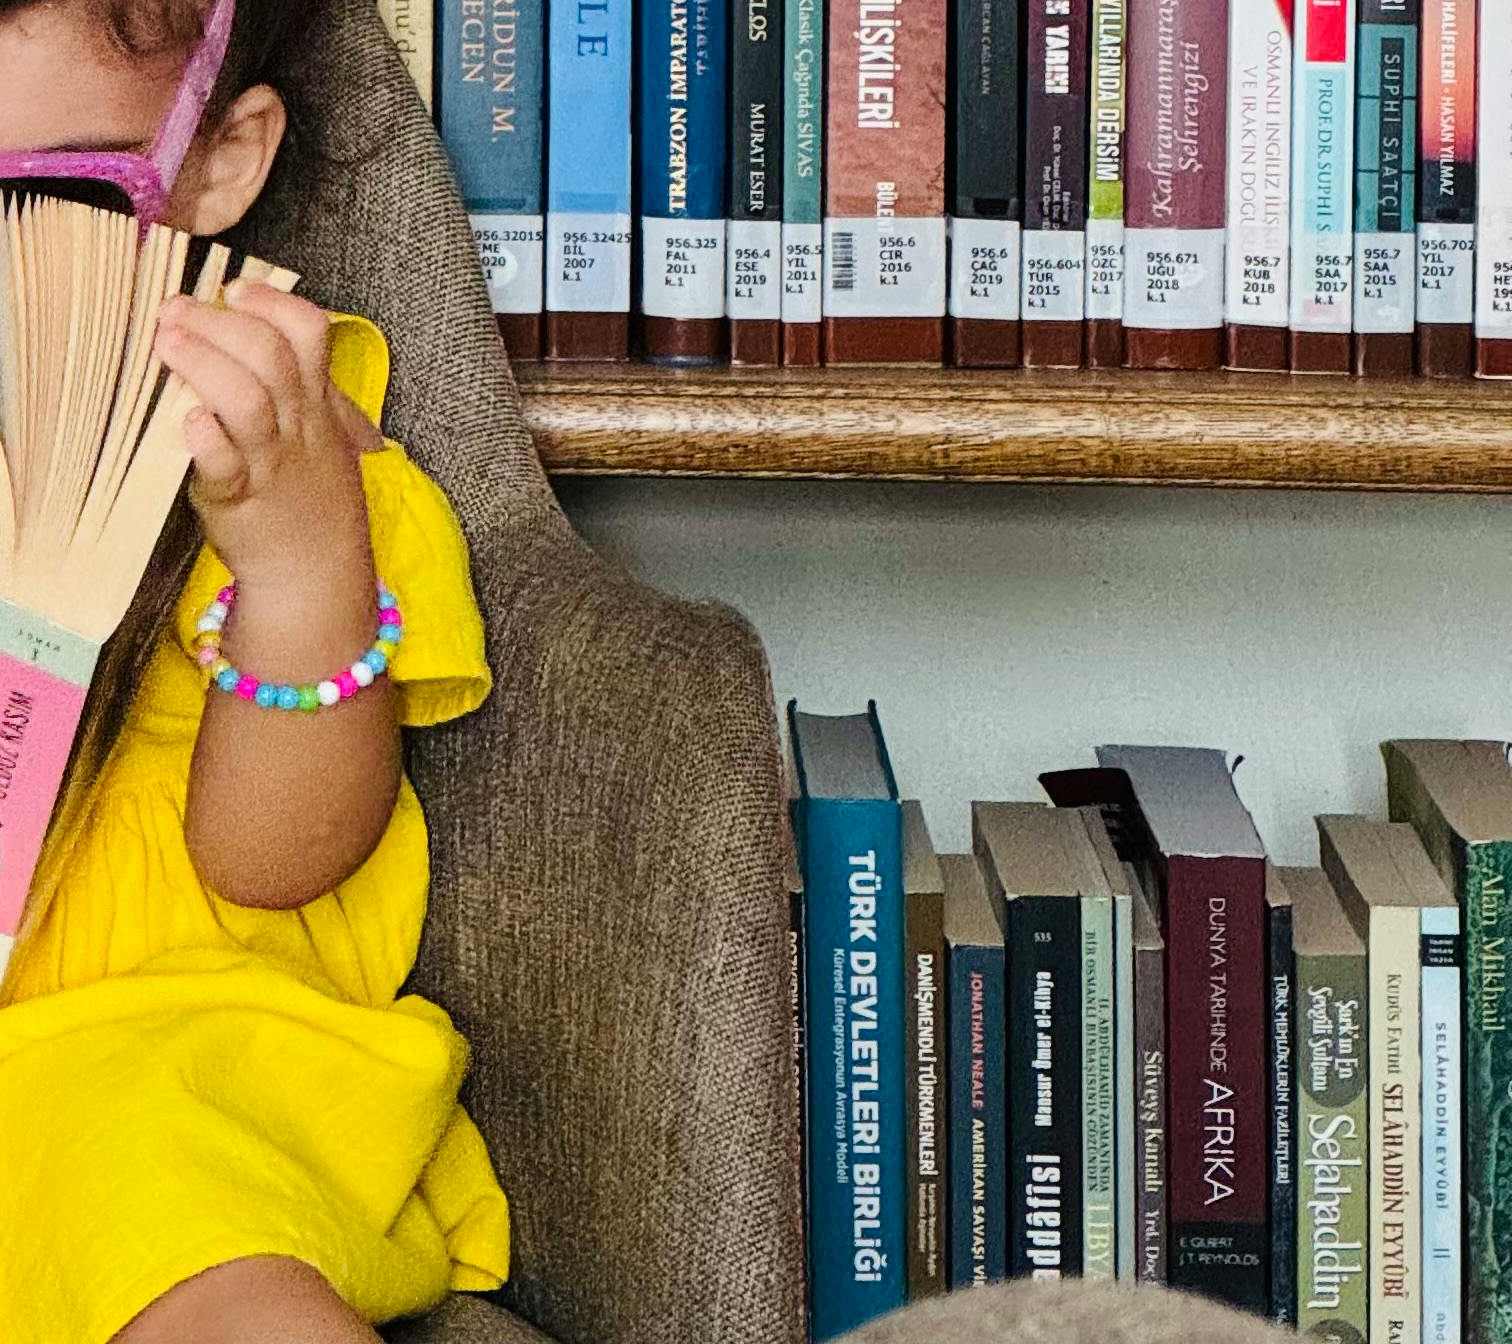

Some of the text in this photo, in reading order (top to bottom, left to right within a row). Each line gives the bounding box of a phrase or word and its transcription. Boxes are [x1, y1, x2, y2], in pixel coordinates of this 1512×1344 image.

[749, 102, 767, 211] MURAT ESER
[562, 258, 594, 268] 2007
[665, 238, 716, 249] 956.325
[665, 251, 687, 261] FAL
[878, 237, 916, 248] 956.6
[1146, 252, 1199, 264] 956.671
[1146, 279, 1180, 290] 2018
[1480, 867, 1505, 1032] Alan Mikhail
[847, 849, 888, 1282] TÜRK DEVLETLERİ BİRLİĞİ
[914, 953, 940, 1176] DANİŞMENDLİ TÜRKMENLERİ
[971, 972, 987, 1200] JONATHAN NEALE AMERİKAN
[1140, 1050, 1164, 1192] Süveyş Kanalı
[1302, 1113, 1361, 1310] Selahaddin
